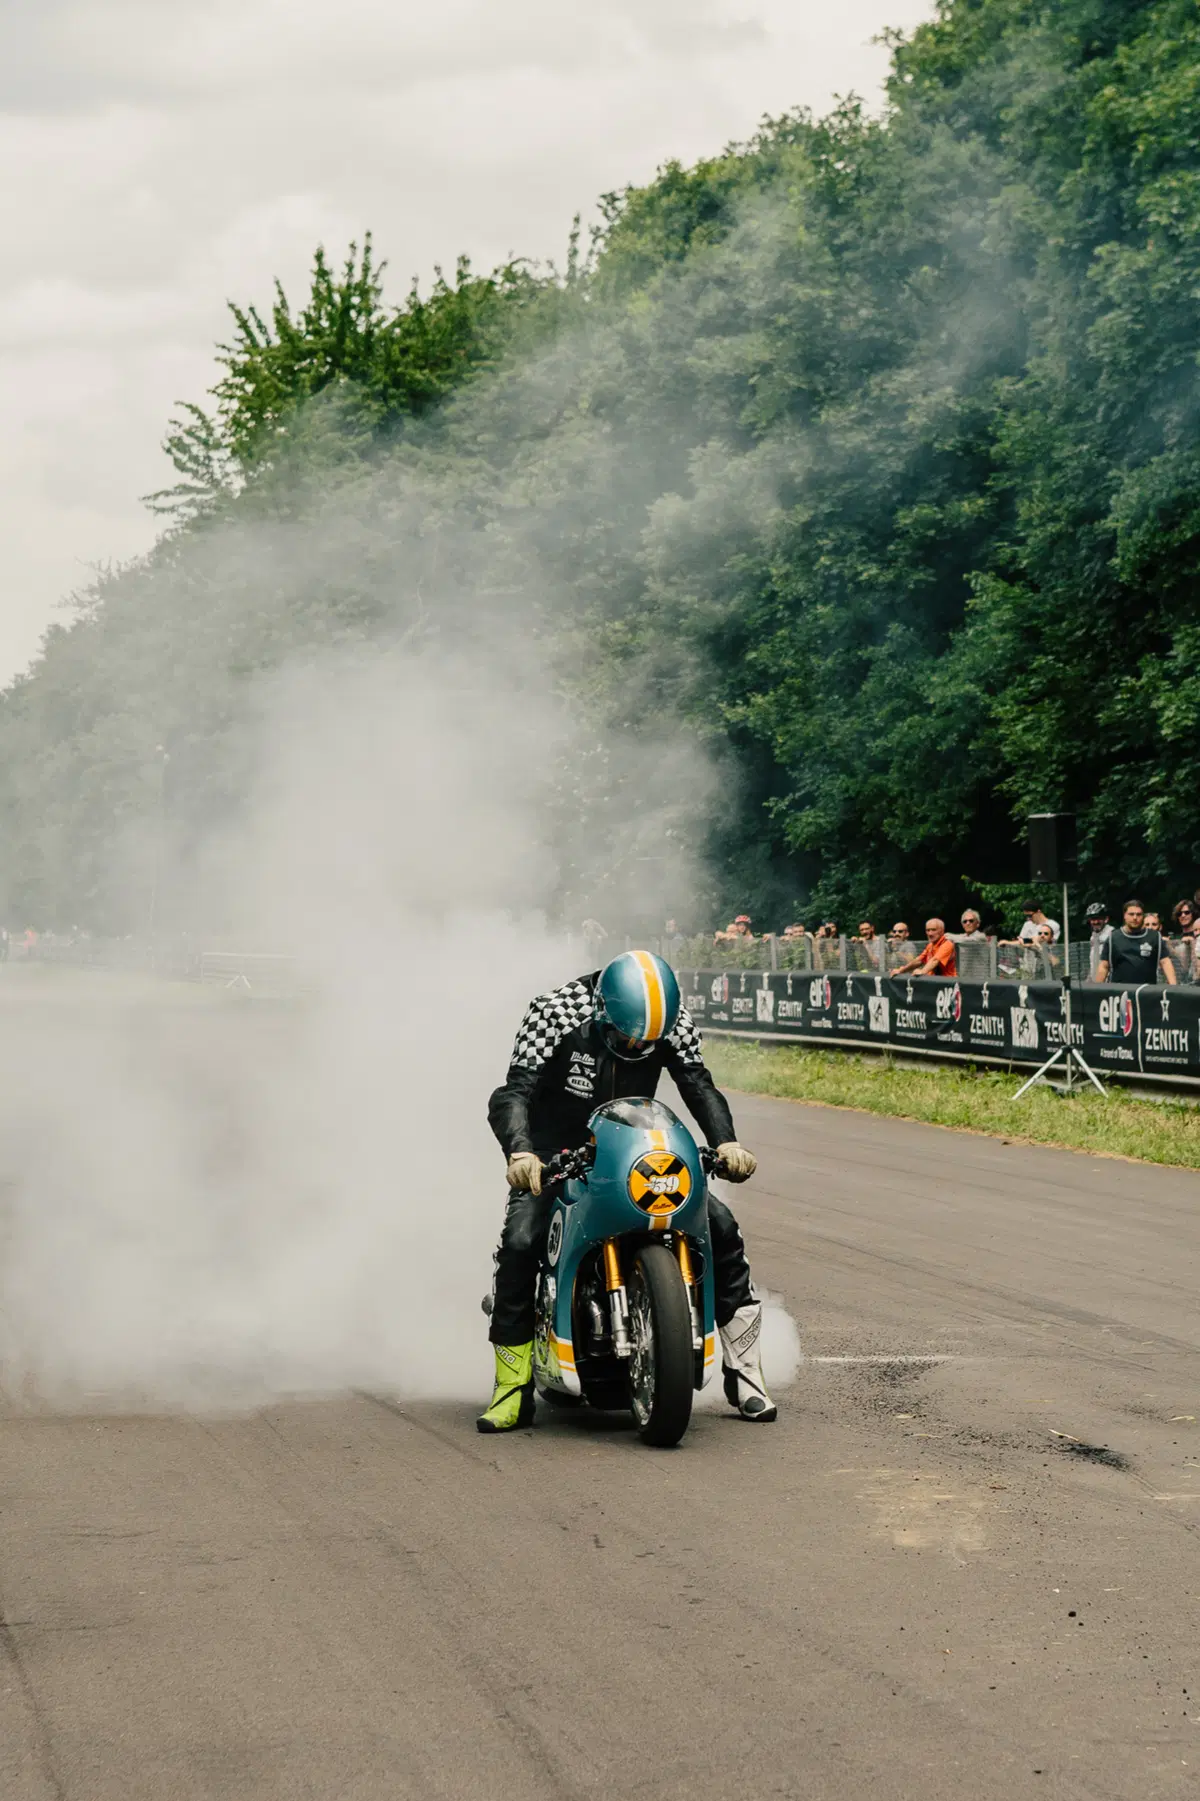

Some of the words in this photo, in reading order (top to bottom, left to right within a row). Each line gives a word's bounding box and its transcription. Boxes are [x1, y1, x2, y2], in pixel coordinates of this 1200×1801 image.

[809, 978, 823, 1008] elf
[936, 986, 953, 1019] elf
[778, 1000, 803, 1018] ZENITH
[837, 1002, 864, 1021] ZENITH
[895, 1008, 927, 1030] ZENITH
[1098, 996, 1121, 1033] elf
[969, 1014, 1005, 1036] ZENITH
[1044, 1021, 1085, 1045] ZENTH
[1145, 1028, 1189, 1052] ZENITH
[571, 1078, 590, 1088] BELL
